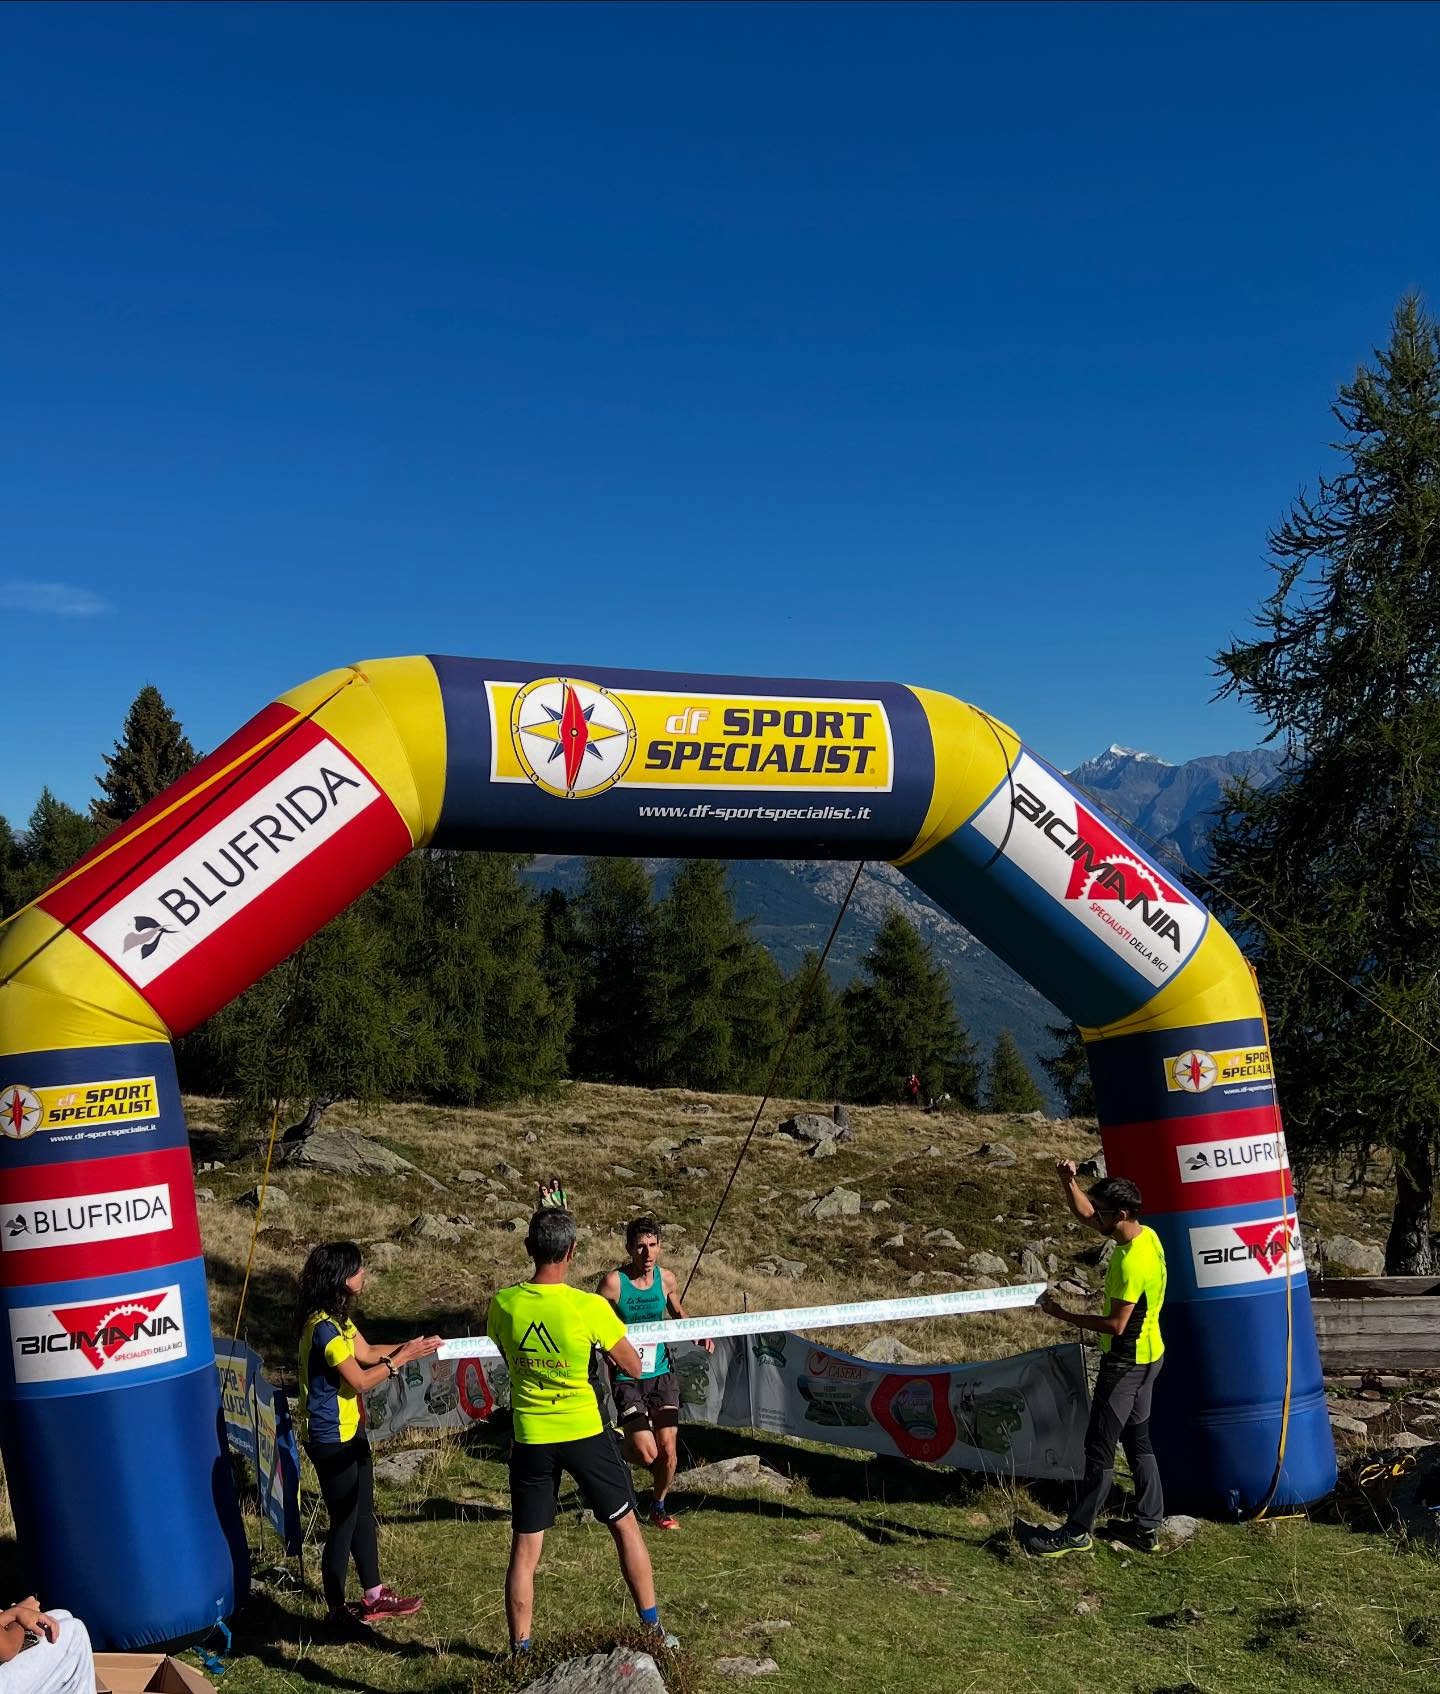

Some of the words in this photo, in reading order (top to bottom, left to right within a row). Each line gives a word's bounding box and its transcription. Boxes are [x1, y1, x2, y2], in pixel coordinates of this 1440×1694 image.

[665, 706, 710, 736] df
[721, 707, 873, 740] SPORT
[644, 740, 876, 774] SPECIALIST
[638, 804, 872, 821] www.df-sportspecialist.it
[157, 767, 361, 926] BLUFRIDA
[1012, 782, 1181, 954] BICIMANIA
[1089, 902, 1131, 941] SPECIALISTI
[1128, 937, 1154, 963] DELLA
[1151, 955, 1169, 973] BICI
[48, 1098, 152, 1123] SPECIALIST
[85, 1083, 152, 1104] SPORT
[49, 1124, 157, 1144] www.df-sportspecialist.it
[34, 1195, 168, 1234] BLUFRIDA
[674, 1318, 723, 1330] VERTICAL
[729, 1313, 777, 1325] VERTICAL
[941, 1291, 986, 1304] VERTICAL
[992, 1285, 1040, 1298] VERTICAL
[15, 1315, 181, 1356] BICIMANIA
[114, 1348, 153, 1362] SPECIALISTI
[153, 1343, 172, 1354] DELLA
[512, 1358, 572, 1369] VERTICAL
